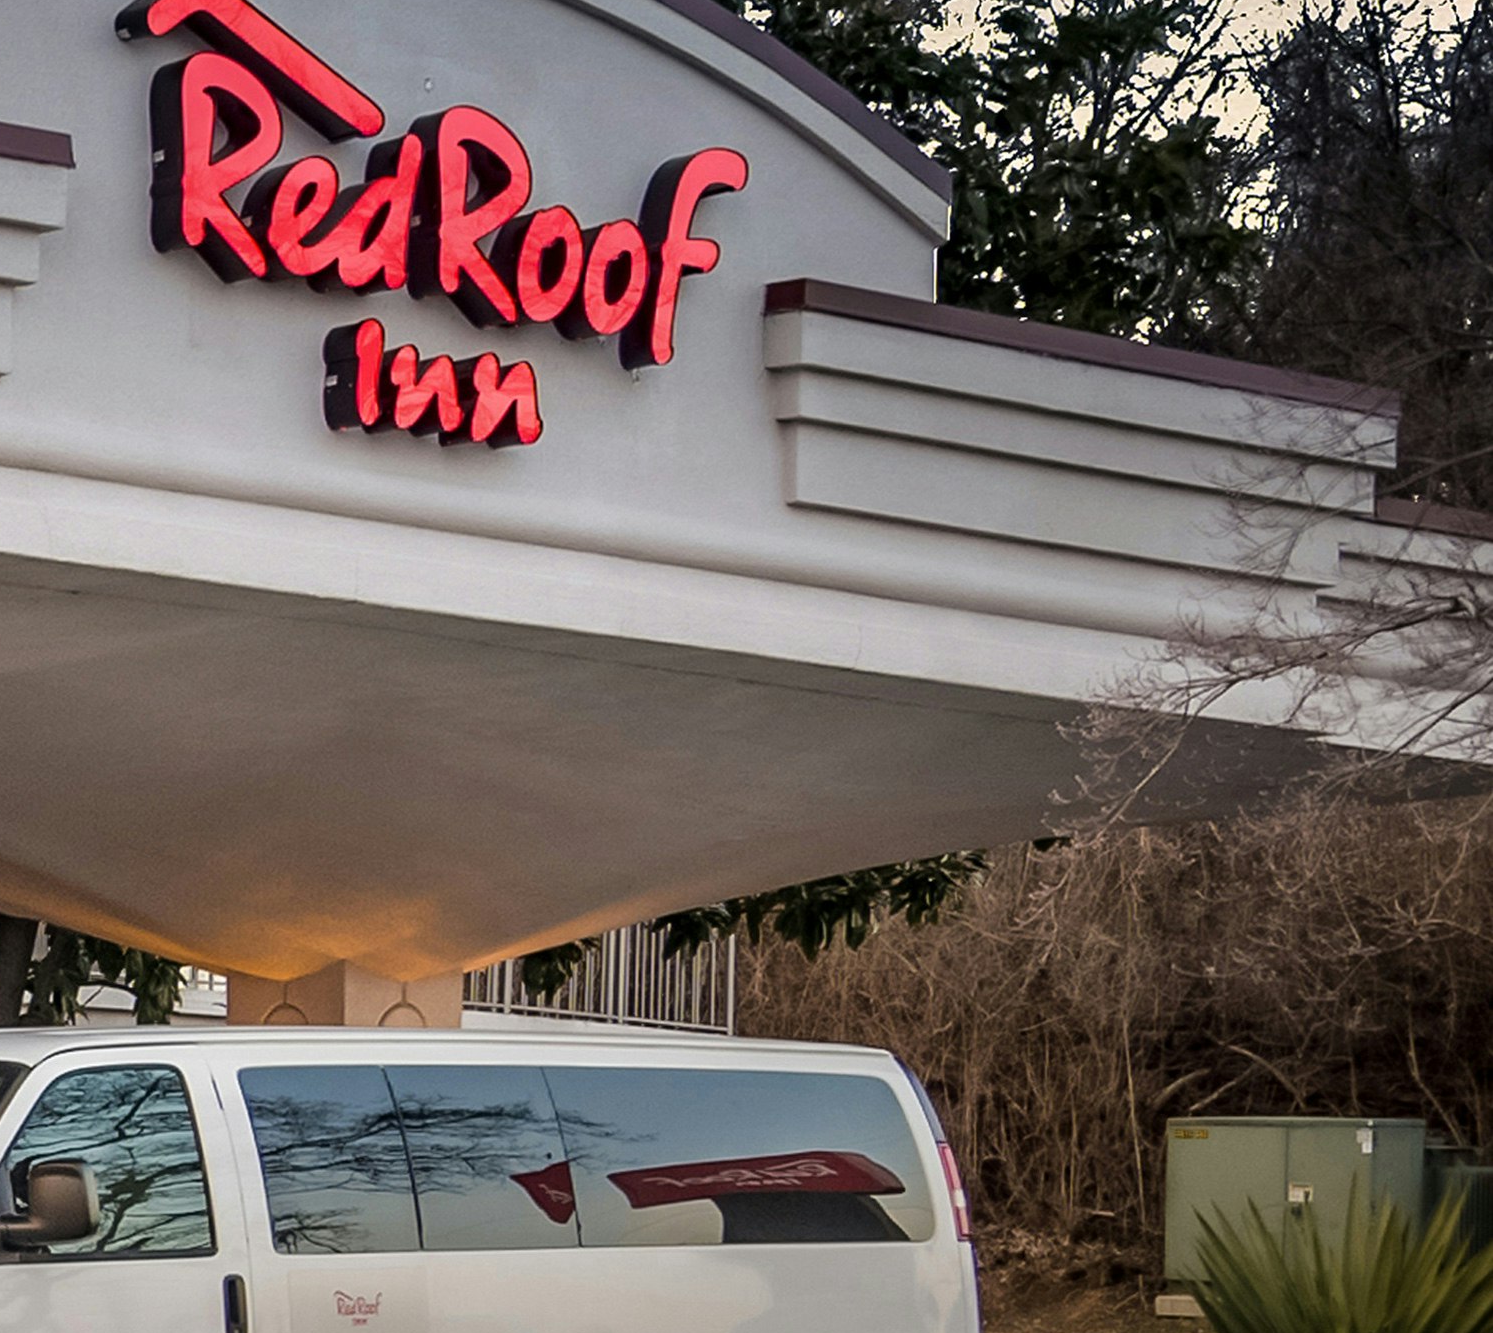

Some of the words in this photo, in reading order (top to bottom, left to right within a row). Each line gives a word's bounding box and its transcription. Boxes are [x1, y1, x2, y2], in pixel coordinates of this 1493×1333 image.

[176, 50, 425, 292] Red
[435, 104, 749, 366] Roof
[346, 318, 543, 446] Inn
